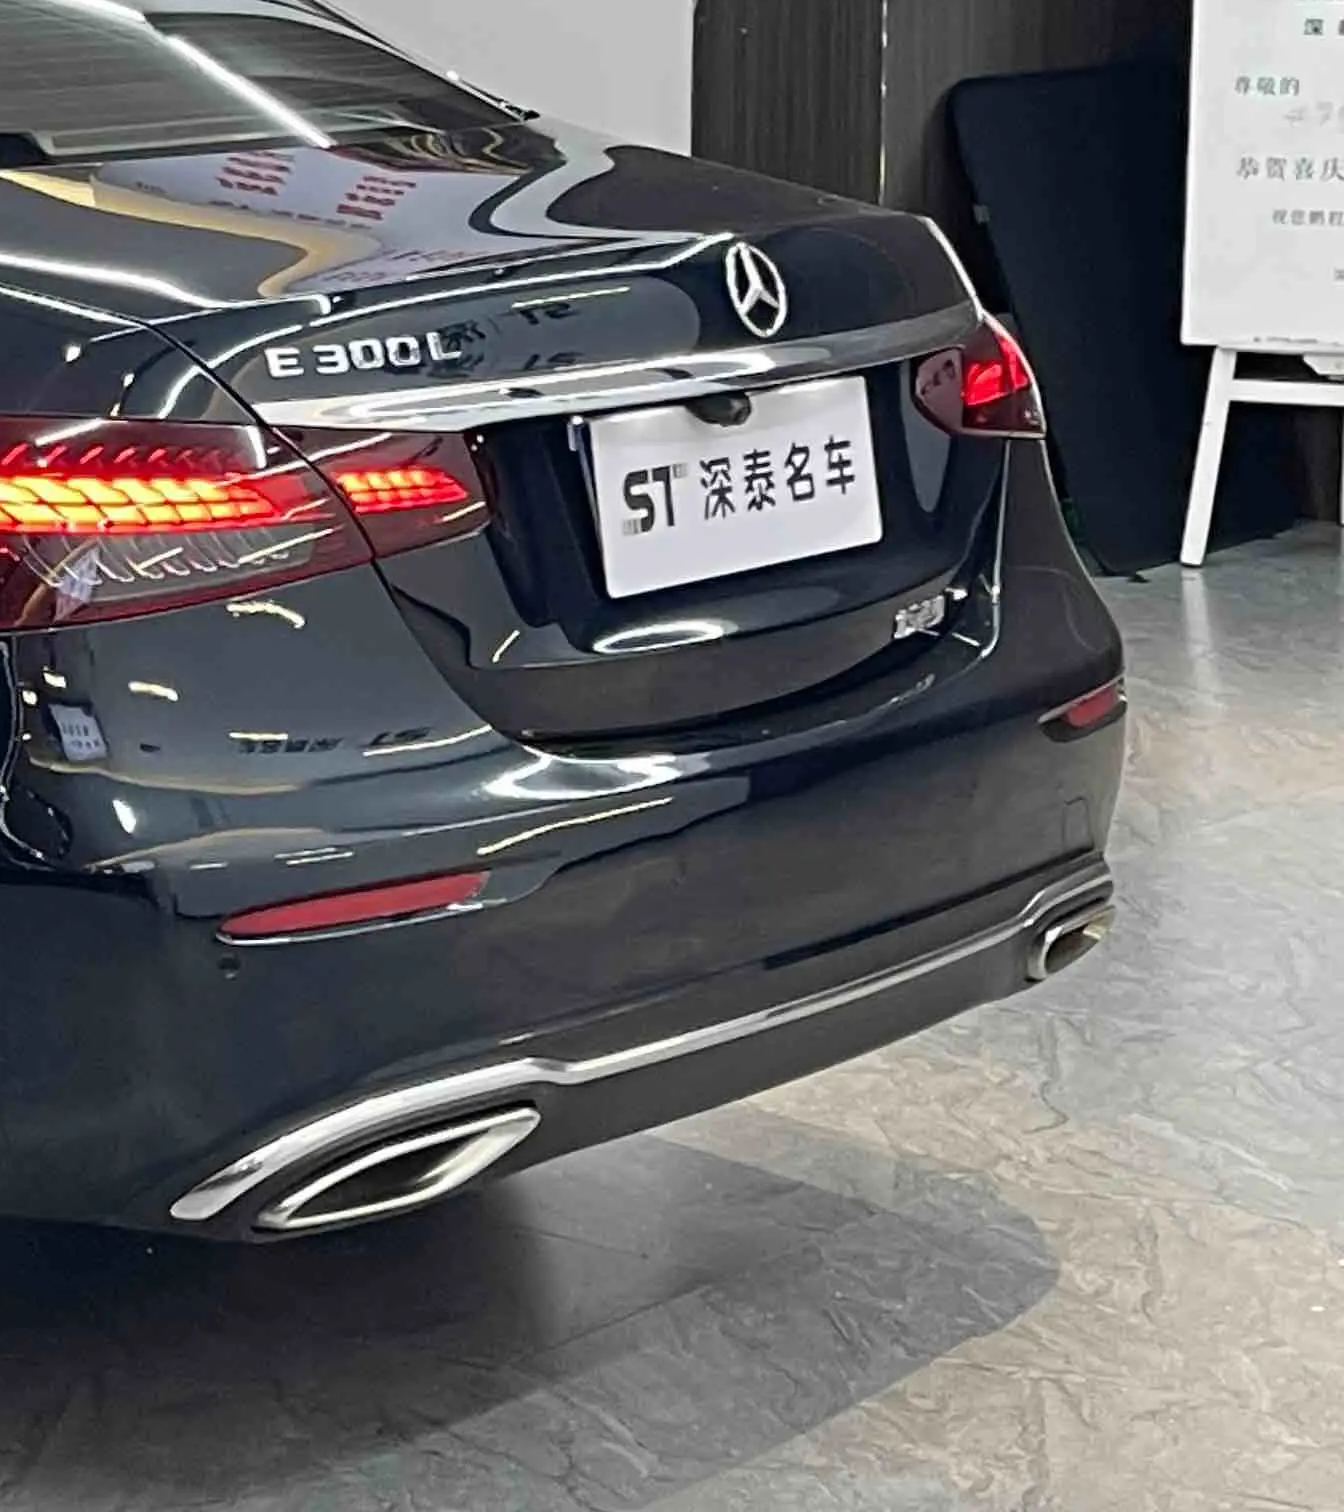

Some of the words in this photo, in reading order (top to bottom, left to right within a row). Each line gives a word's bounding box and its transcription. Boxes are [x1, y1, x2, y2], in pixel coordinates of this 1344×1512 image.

[623, 464, 676, 535] ST
[700, 435, 856, 521] 深泰名车
